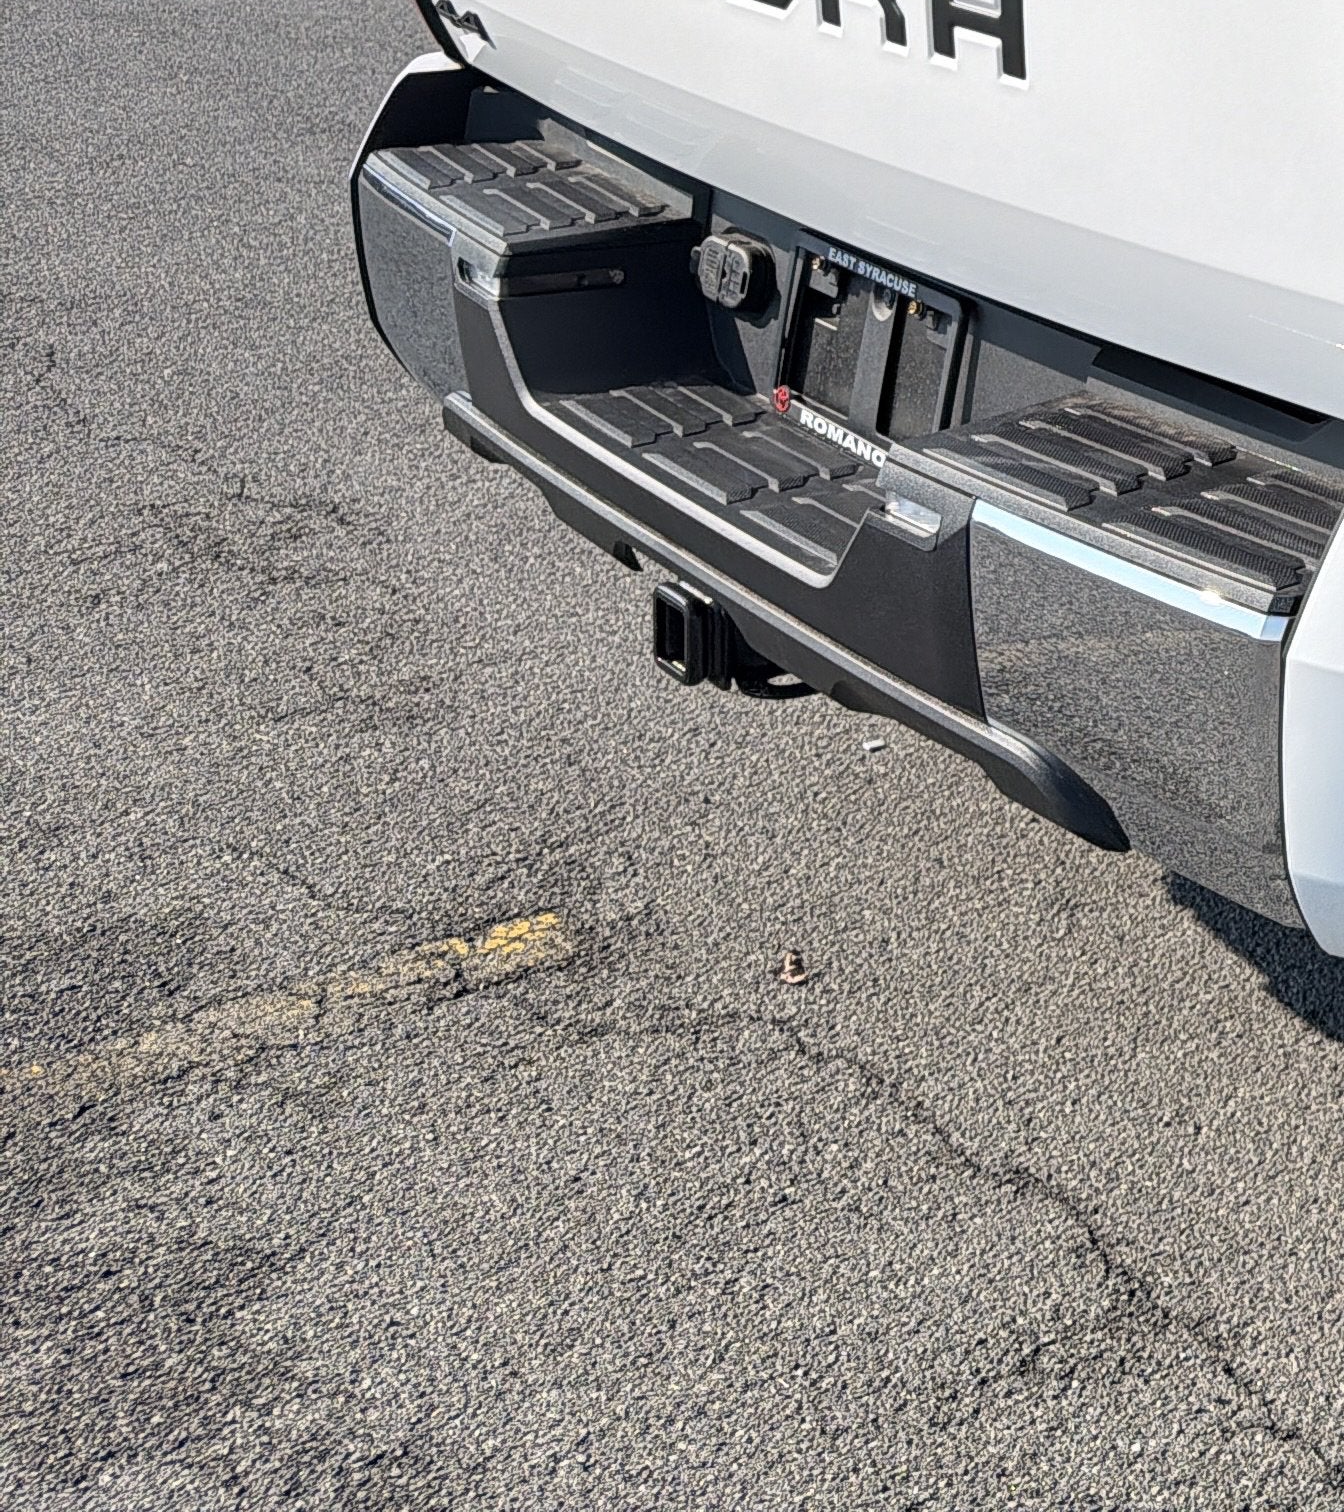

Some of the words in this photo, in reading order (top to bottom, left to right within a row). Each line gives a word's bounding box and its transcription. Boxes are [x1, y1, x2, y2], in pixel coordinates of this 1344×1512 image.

[828, 247, 857, 271] EAST
[857, 260, 917, 298] SYRACUSE
[799, 409, 887, 468] ROMANO
